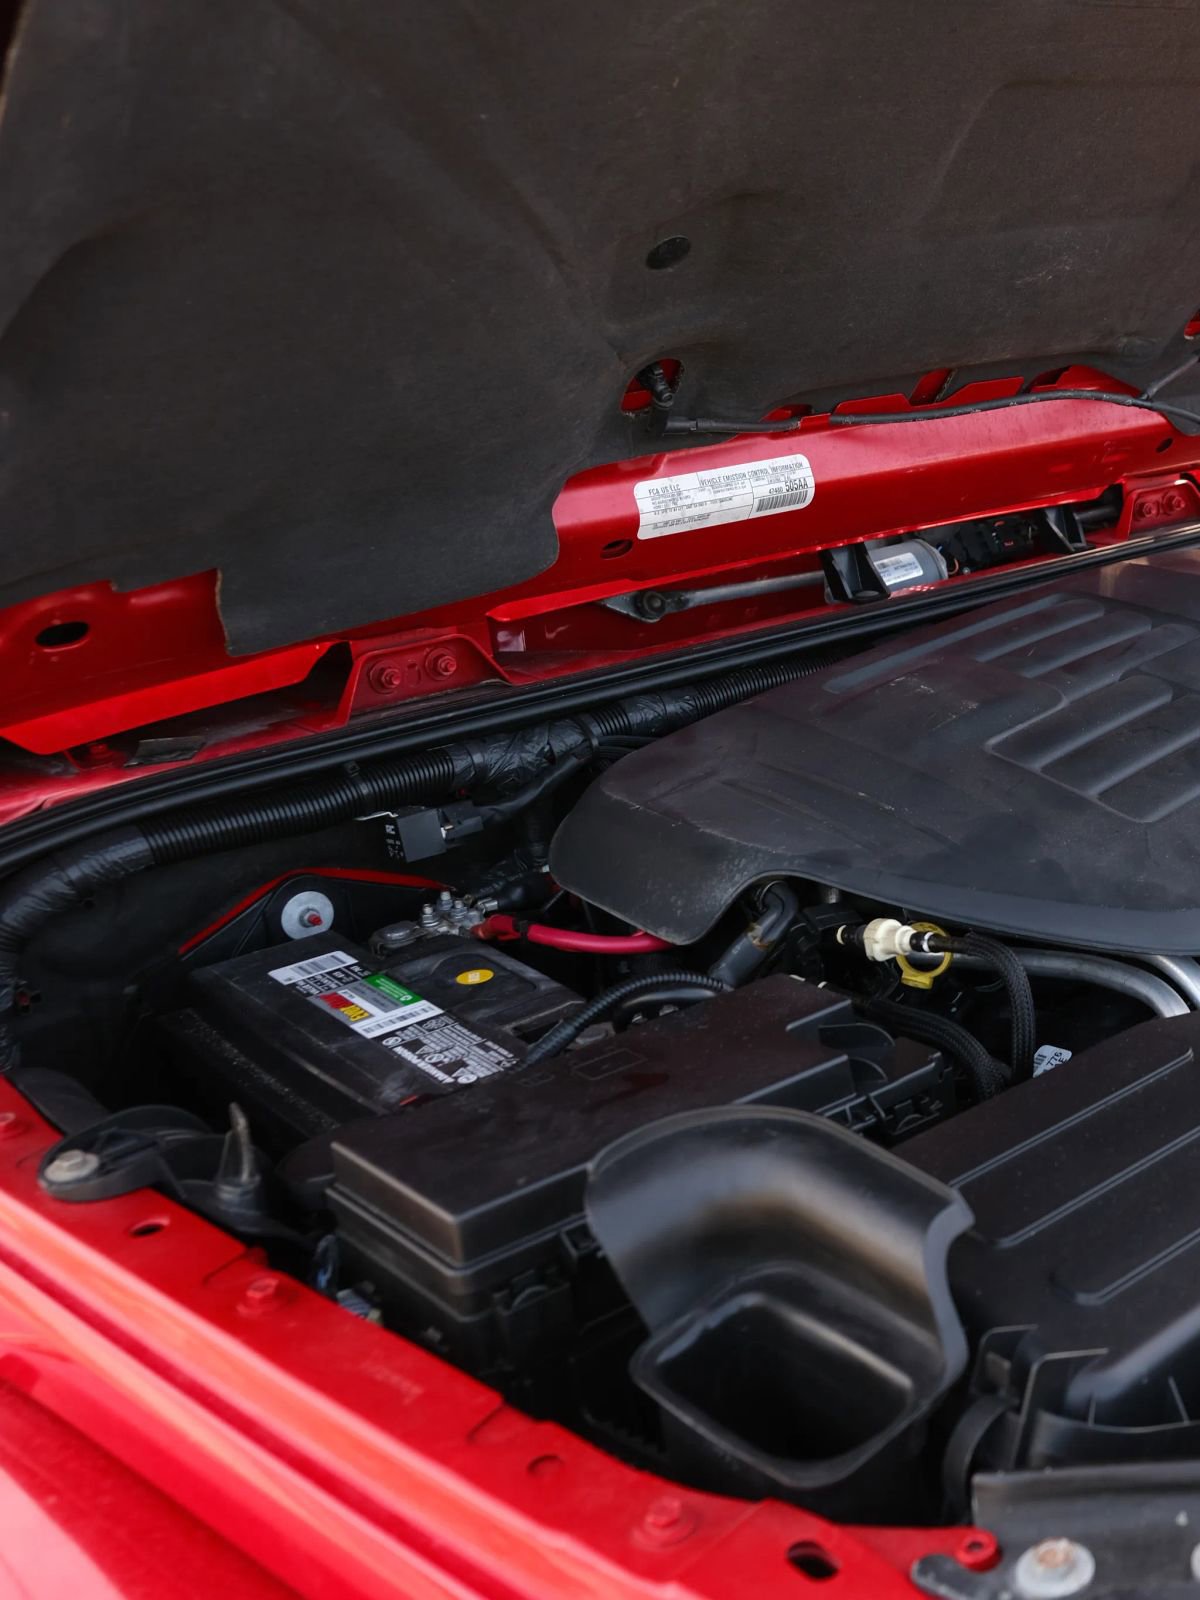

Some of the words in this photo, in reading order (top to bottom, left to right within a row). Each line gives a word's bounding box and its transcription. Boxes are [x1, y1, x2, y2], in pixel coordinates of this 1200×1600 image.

[700, 475, 721, 486] VEHICLE
[747, 467, 769, 479] CONTROL
[648, 487, 660, 496] FCA
[660, 485, 670, 494] US
[784, 477, 809, 492] 505AA
